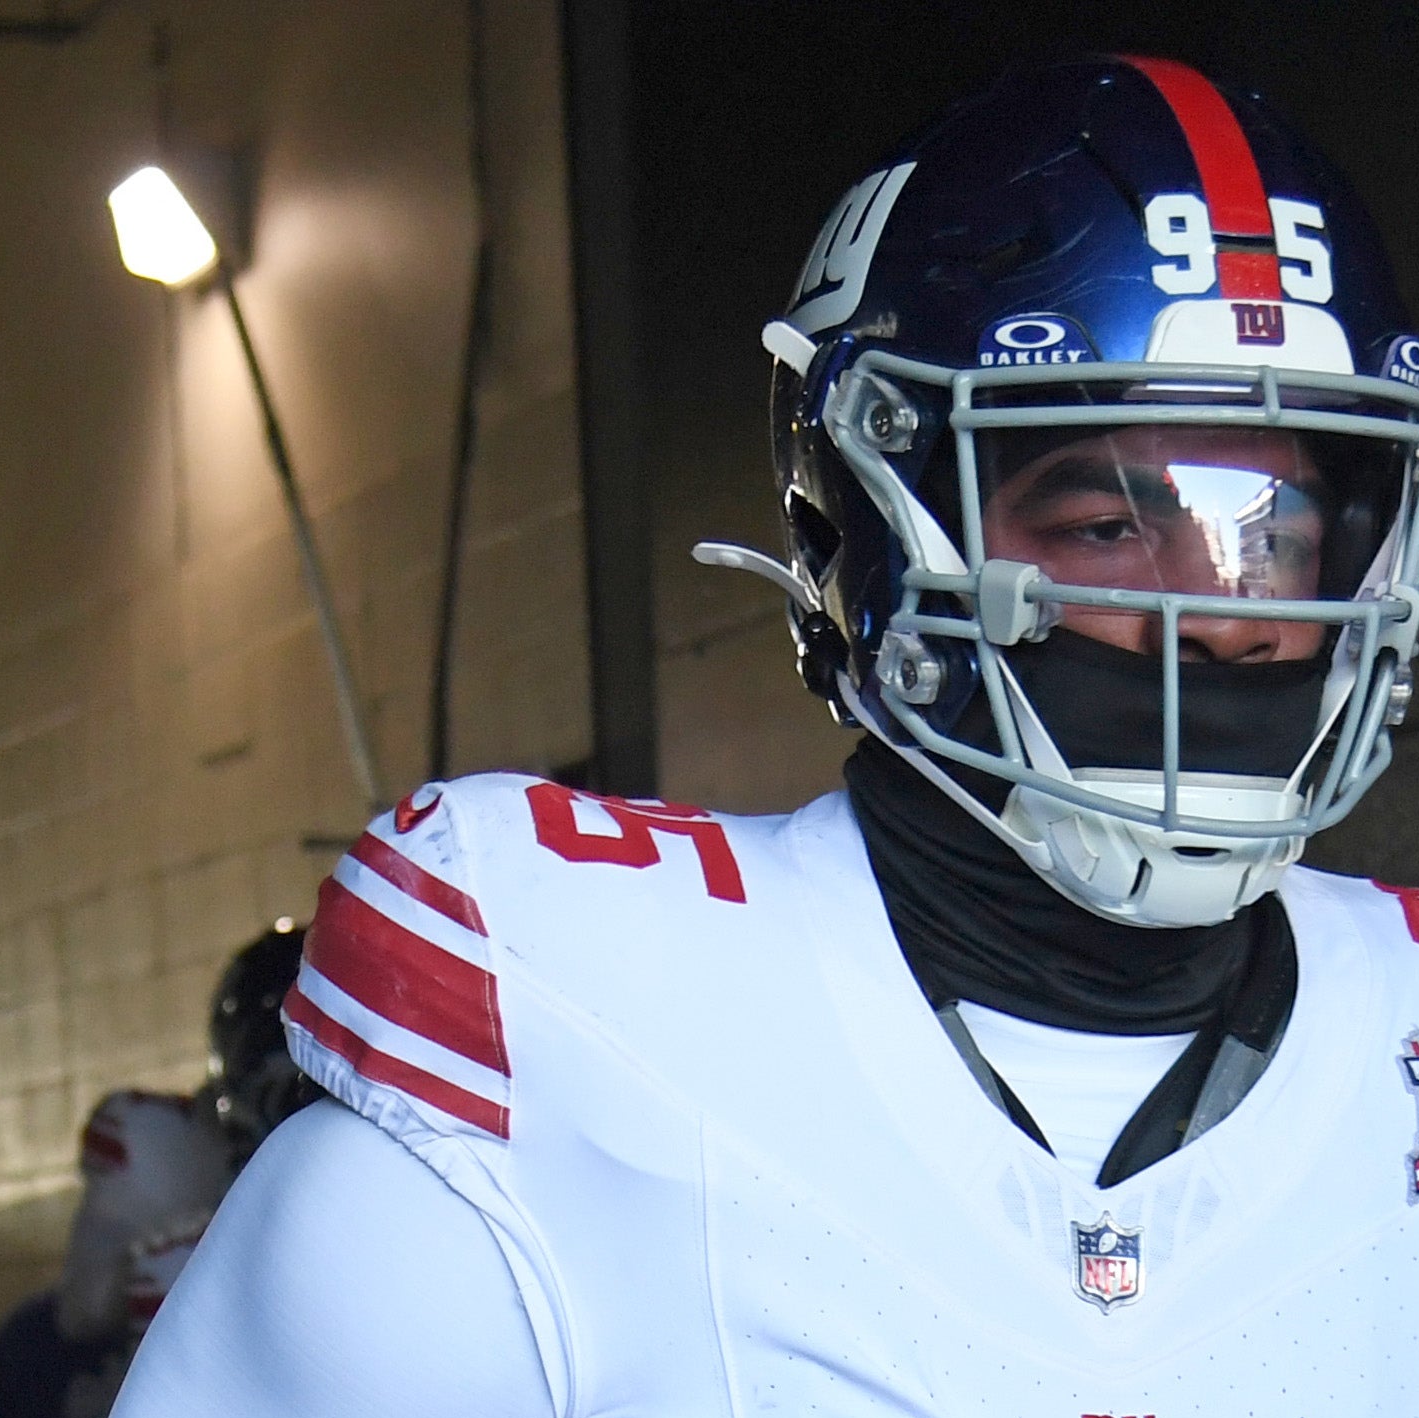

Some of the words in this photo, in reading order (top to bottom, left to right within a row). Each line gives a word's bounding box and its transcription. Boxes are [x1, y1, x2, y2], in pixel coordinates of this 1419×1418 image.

[1144, 194, 1333, 304] 95
[981, 350, 1082, 367] OAKLEY
[1084, 1256, 1133, 1295] NFL
